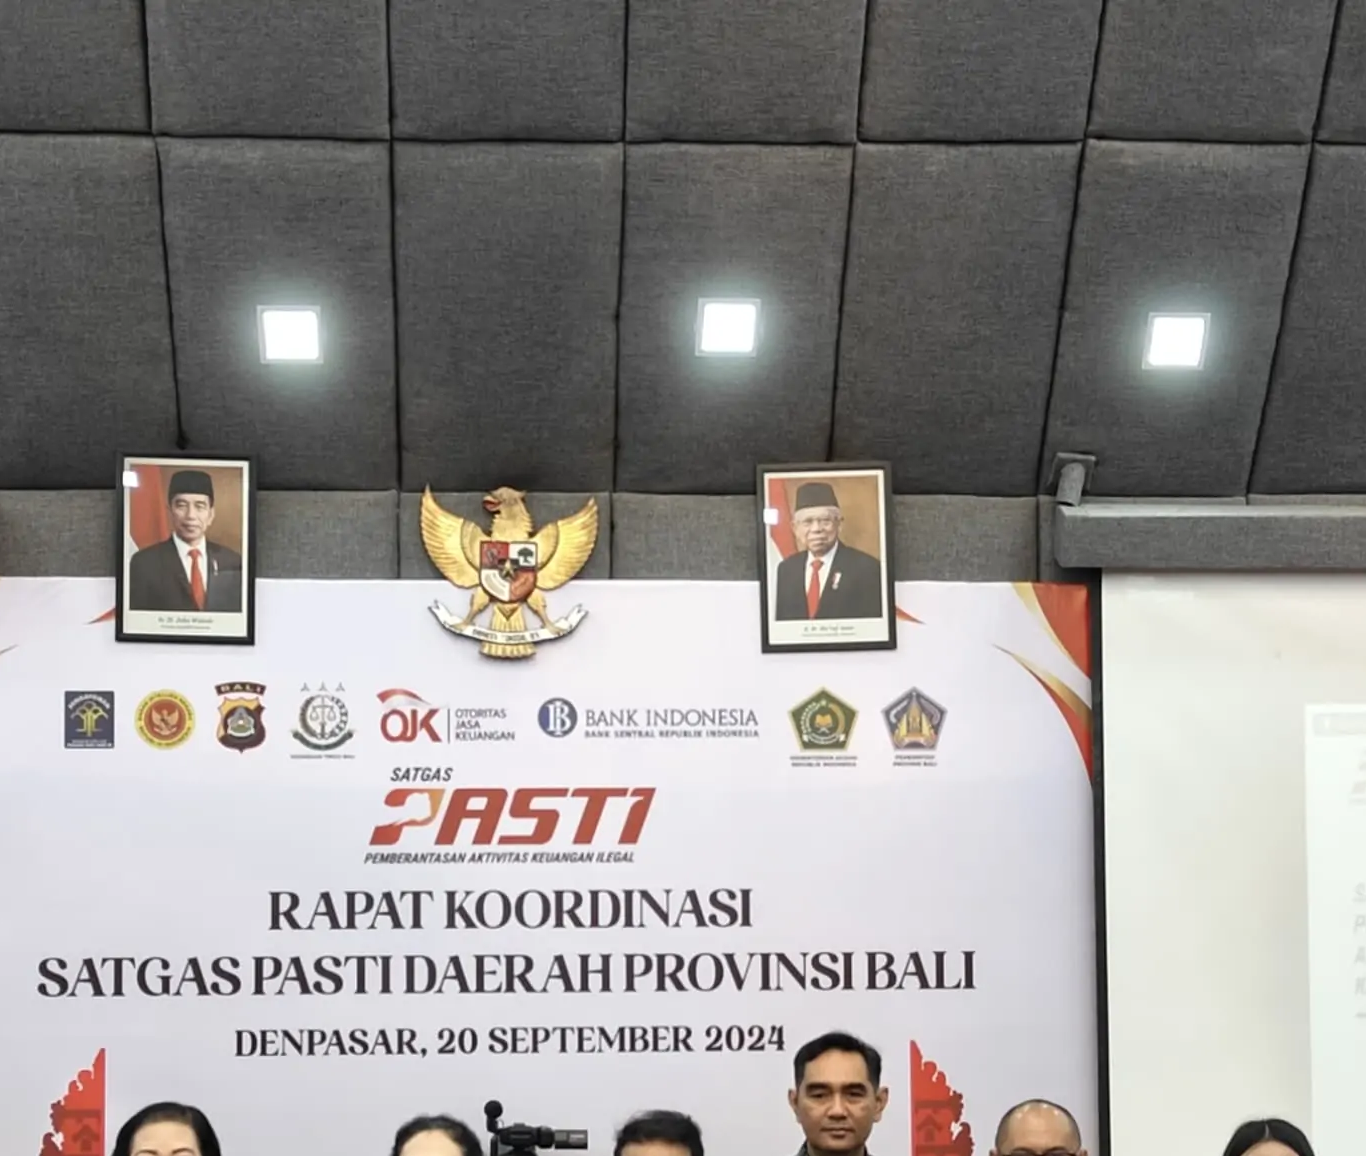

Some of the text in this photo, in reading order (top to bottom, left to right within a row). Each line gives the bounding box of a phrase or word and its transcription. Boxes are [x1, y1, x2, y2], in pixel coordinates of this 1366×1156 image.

[454, 708, 507, 719] OTORITAS
[585, 708, 759, 727] BANK INDONESIA
[380, 708, 443, 743] OJK
[454, 719, 481, 731] JASA
[584, 730, 759, 738] BANK SENTRAL REPUBLIK INDONESIA
[454, 731, 515, 742] KEUANGAN
[390, 766, 454, 783] SATGAS
[368, 787, 657, 846] PASTI
[364, 851, 635, 864] PEMBERANTASAN AKTIVITAS KEUANGAN ILEGAL
[268, 888, 753, 931] RAPAT KOORDINASI
[37, 950, 976, 998] SATGAS PASTI DAERAH PROVINSI BALI
[235, 1024, 785, 1058] DENPASAR, 20 SEPTEMBER 2024
